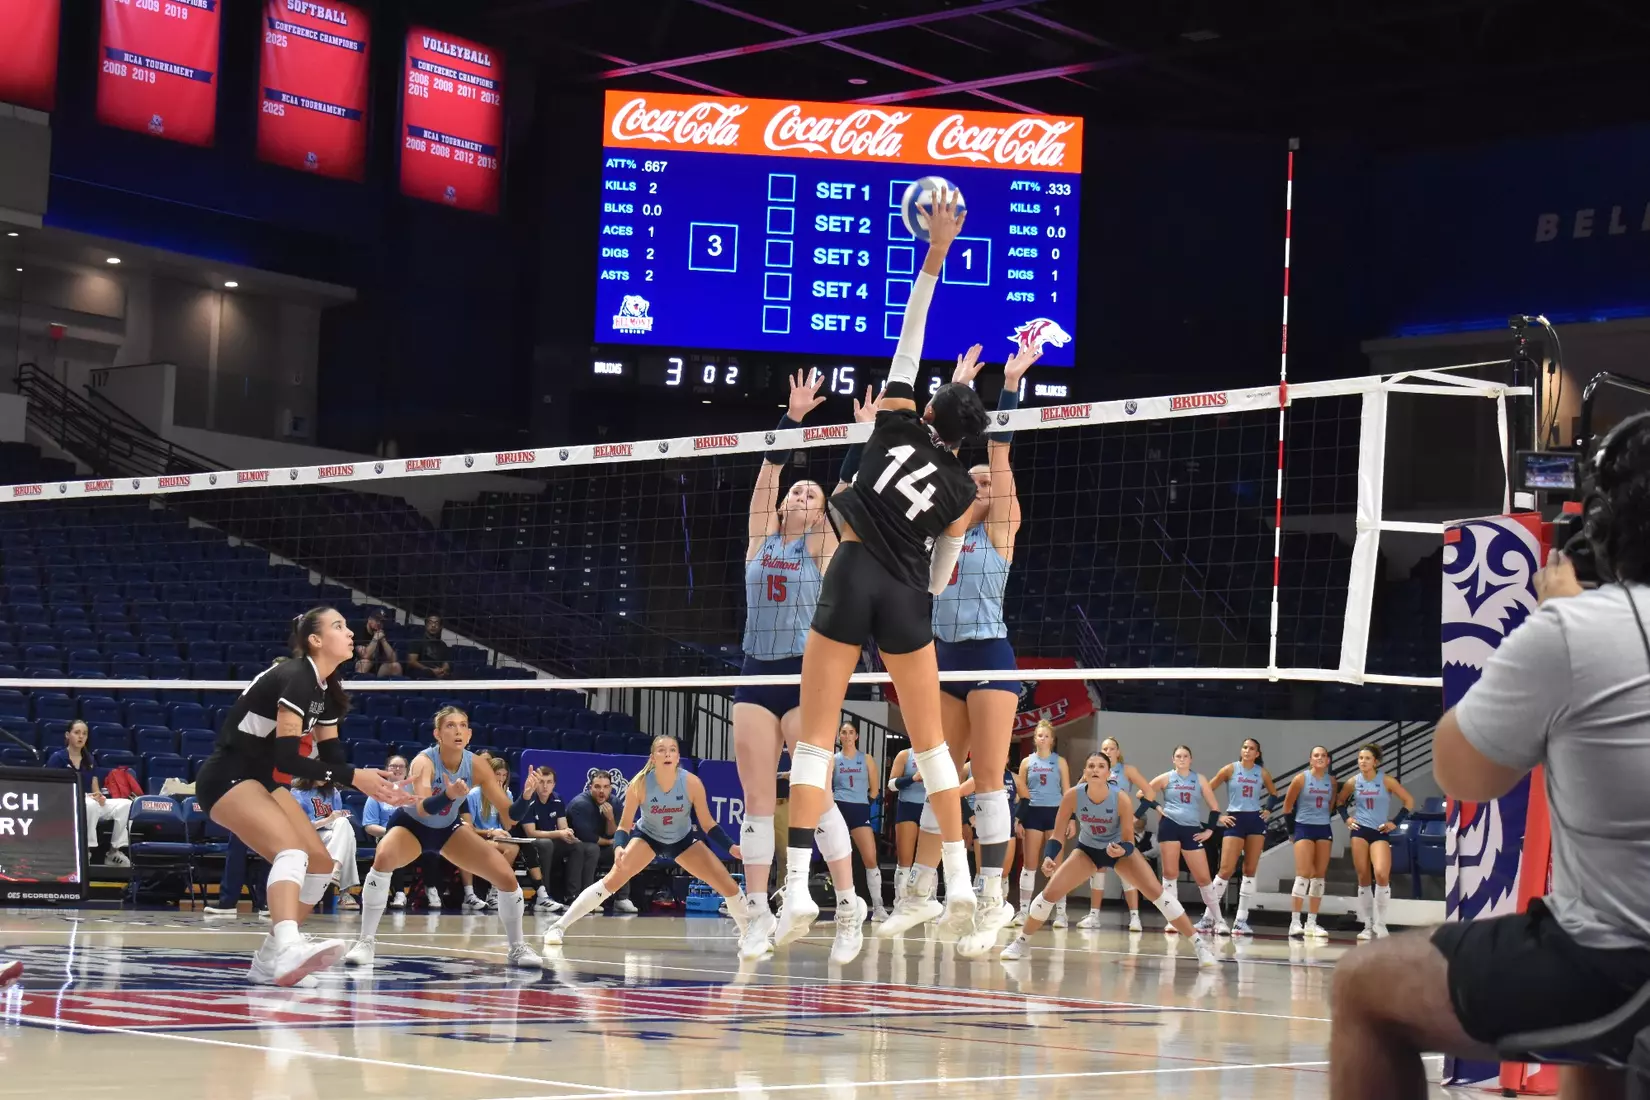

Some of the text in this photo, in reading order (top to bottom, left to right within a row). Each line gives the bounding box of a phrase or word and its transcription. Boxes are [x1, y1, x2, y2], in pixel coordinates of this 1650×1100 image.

[164, 4, 188, 20] 2019
[286, 0, 348, 26] SOFTBALL
[266, 32, 288, 48] 2025
[275, 21, 358, 50] CONFERENCE CHAMPIONS
[422, 36, 492, 67] VOLLEYBALL
[103, 60, 156, 84] 2008 2019
[124, 52, 194, 78] NCAA TOURNAMENT
[418, 60, 494, 89] CONFERENCE CHAMPIONS
[408, 84, 428, 98] 2015
[409, 71, 500, 106] 2006 2008 2011 2012
[262, 102, 285, 116] 2025
[282, 94, 346, 118] NCAA TOURNAMENT
[611, 98, 749, 146] Coca-Cola
[763, 104, 913, 157] Coca-Cola
[423, 130, 482, 153] NCAA TOURNAMENT
[927, 114, 1076, 167] Coca-Cola
[406, 137, 497, 170] 2006 2008 2012 2015
[606, 158, 668, 172] ATT% .667
[605, 180, 658, 194] KILLS 2
[816, 182, 870, 201] SET 1
[1010, 180, 1072, 196] ATT% .333
[604, 203, 662, 216] BLKS 0.0
[1010, 202, 1061, 216] KILLS 1
[602, 225, 654, 238] ACES 1
[814, 215, 872, 234] SET 2
[1008, 224, 1066, 238] BLKS 0.0
[706, 234, 723, 257] 3
[1008, 247, 1060, 260] ACES 0
[602, 248, 654, 260] DIGS 2
[812, 248, 870, 266] SET 3
[962, 248, 972, 270] 1
[600, 270, 654, 282] ASTS 2
[1007, 269, 1058, 281] DIGS 1
[812, 280, 868, 300] SET 4
[1006, 291, 1057, 302] ASTS 1
[810, 314, 867, 332] SET 5
[666, 357, 683, 386] 3
[703, 365, 738, 384] 0 2
[1170, 392, 1228, 412] BRUINS
[1041, 404, 1092, 422] BELMONT
[803, 425, 848, 442] BELMONT
[694, 434, 739, 450] BRUINS
[496, 451, 536, 466] BRUINS
[593, 444, 634, 458] BELMONT
[318, 464, 354, 479] BRUINS
[405, 458, 442, 472] BELMONT
[158, 476, 190, 488] BRUINS
[236, 470, 270, 483] BELMONT
[873, 444, 938, 522] 14
[13, 484, 42, 498] BRUINS
[84, 480, 114, 493] BELMONT
[760, 554, 800, 572] Belmont
[766, 574, 788, 602] 15
[849, 775, 854, 788] 1
[1040, 774, 1047, 786] 5
[1180, 792, 1191, 804] 13
[1242, 786, 1253, 798] 21
[142, 800, 173, 812] BELMONT
[650, 804, 684, 814] Belmont
[712, 796, 744, 824] TR
[0, 817, 33, 836] RY
[662, 816, 674, 826] 2
[1090, 825, 1106, 834] 10
[22, 892, 80, 900] SCOREBOARDS
